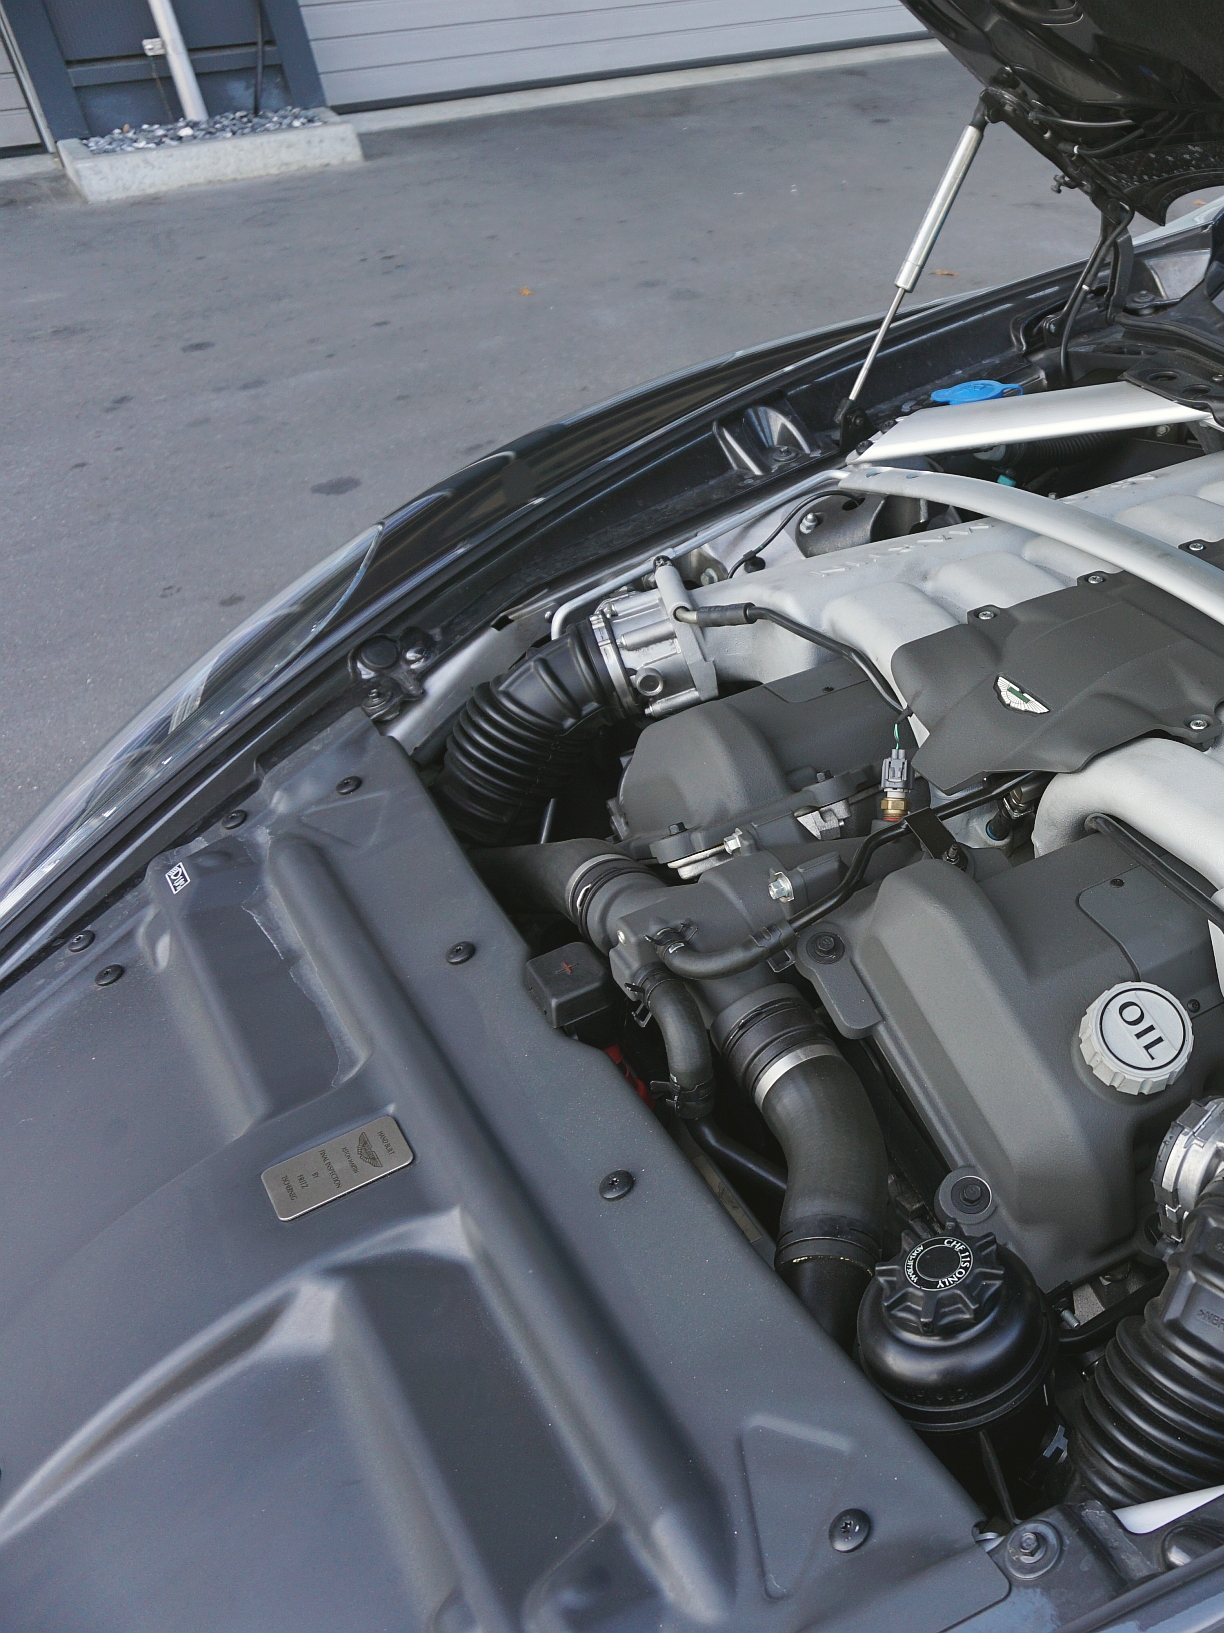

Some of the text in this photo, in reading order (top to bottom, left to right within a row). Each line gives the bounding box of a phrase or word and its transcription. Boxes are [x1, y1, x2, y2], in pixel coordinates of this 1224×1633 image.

[1118, 1001, 1165, 1061] OIL
[296, 1174, 309, 1189] FRITZ
[311, 1171, 319, 1179] BY
[936, 1238, 970, 1289] CHF 11S ONLY
